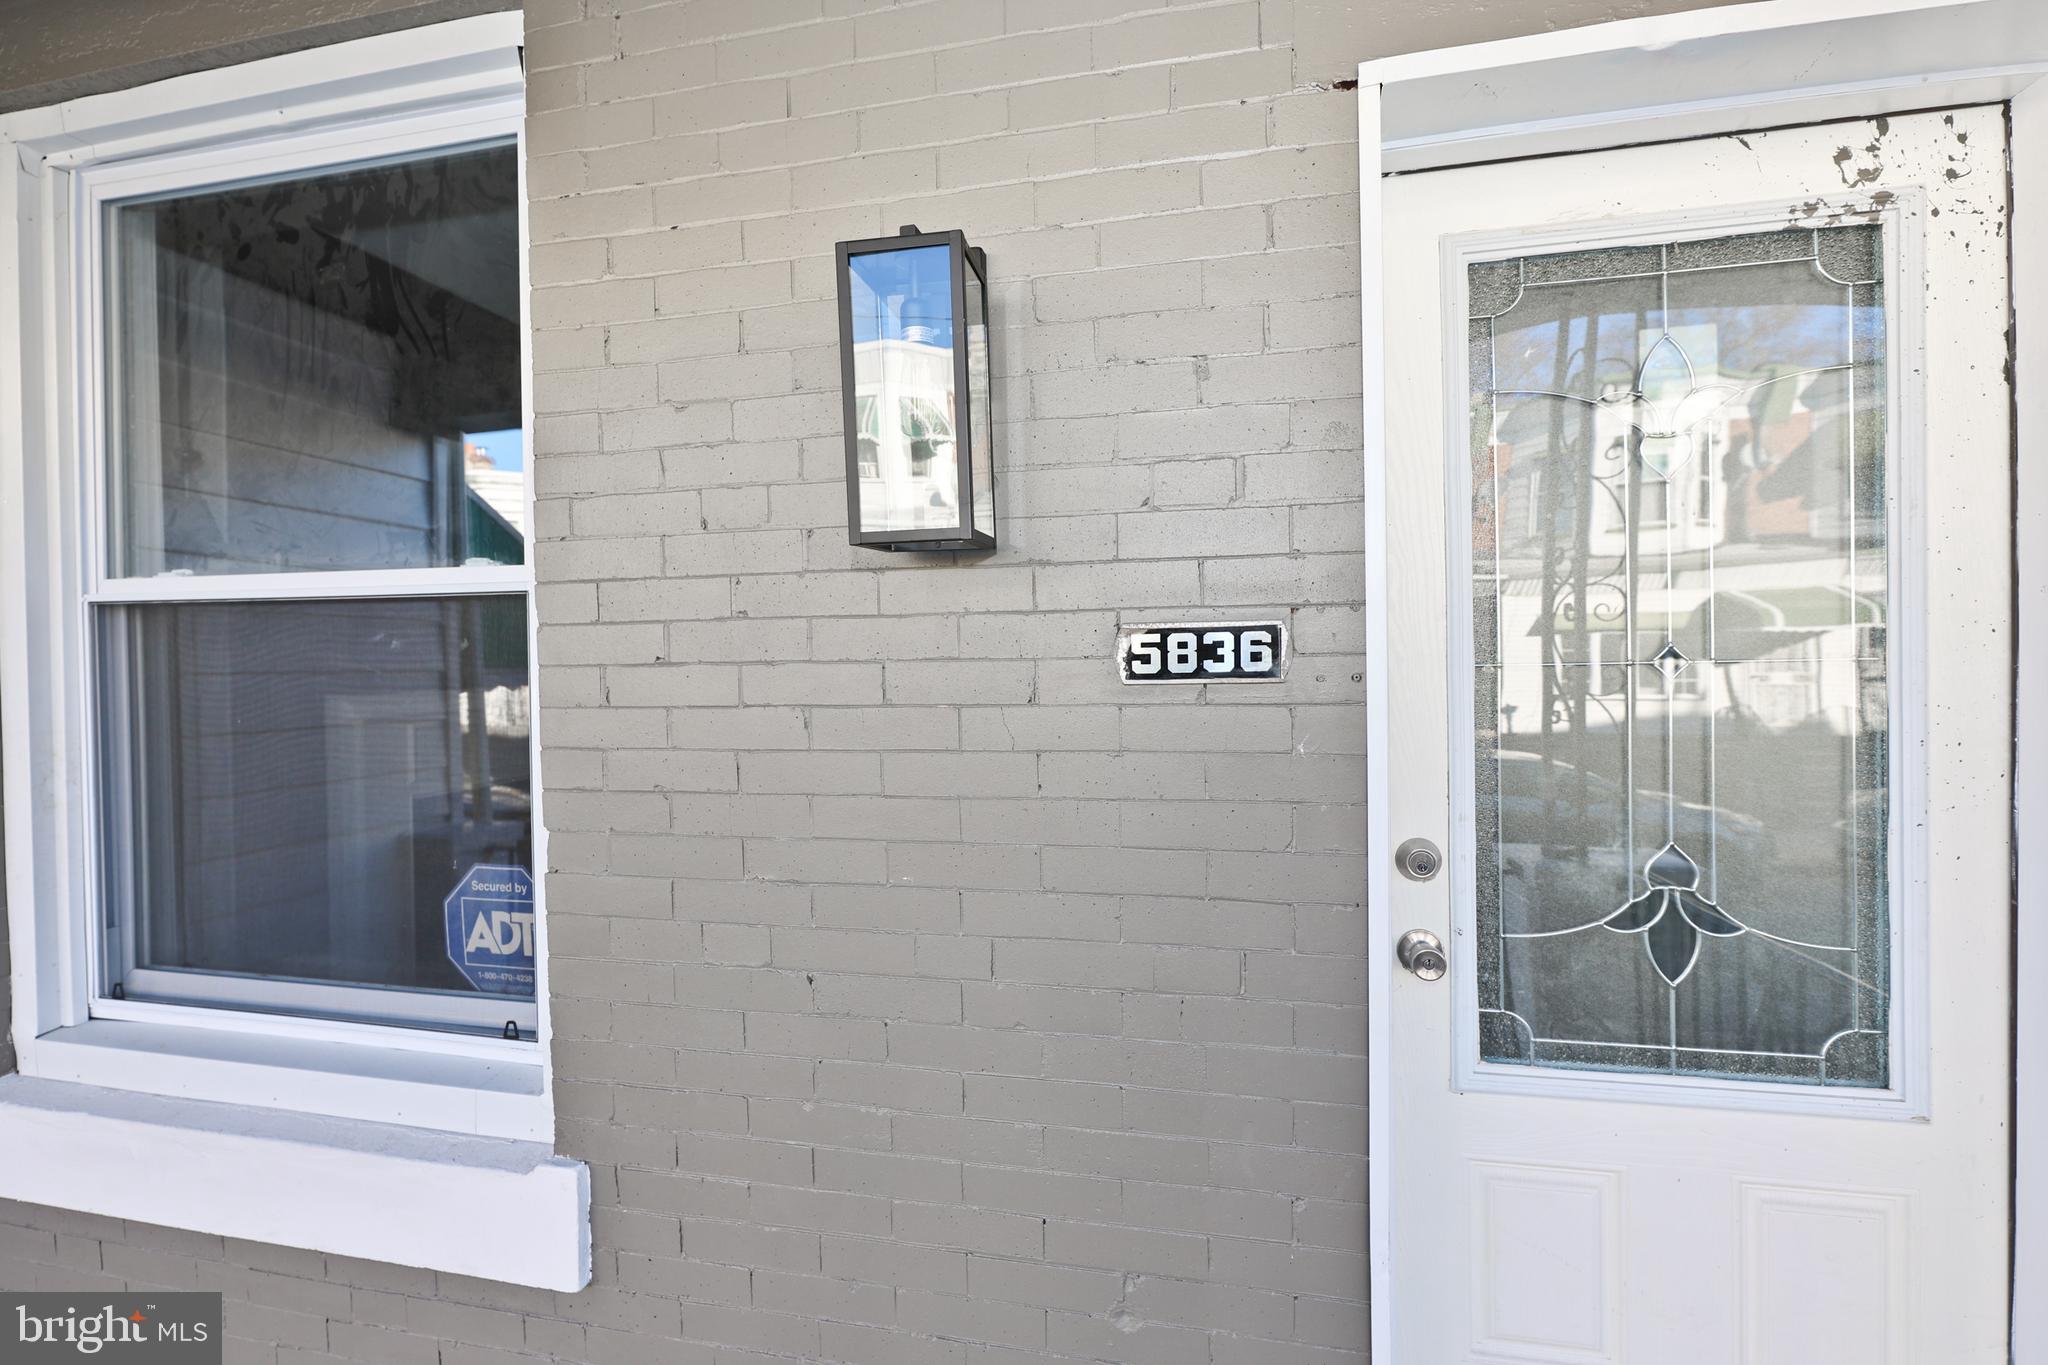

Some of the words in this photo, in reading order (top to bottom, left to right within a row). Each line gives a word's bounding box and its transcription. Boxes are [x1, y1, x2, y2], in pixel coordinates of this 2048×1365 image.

[1131, 631, 1273, 674] 5836
[471, 880, 512, 893] Secured
[514, 883, 528, 896] by
[466, 910, 534, 957] ADT
